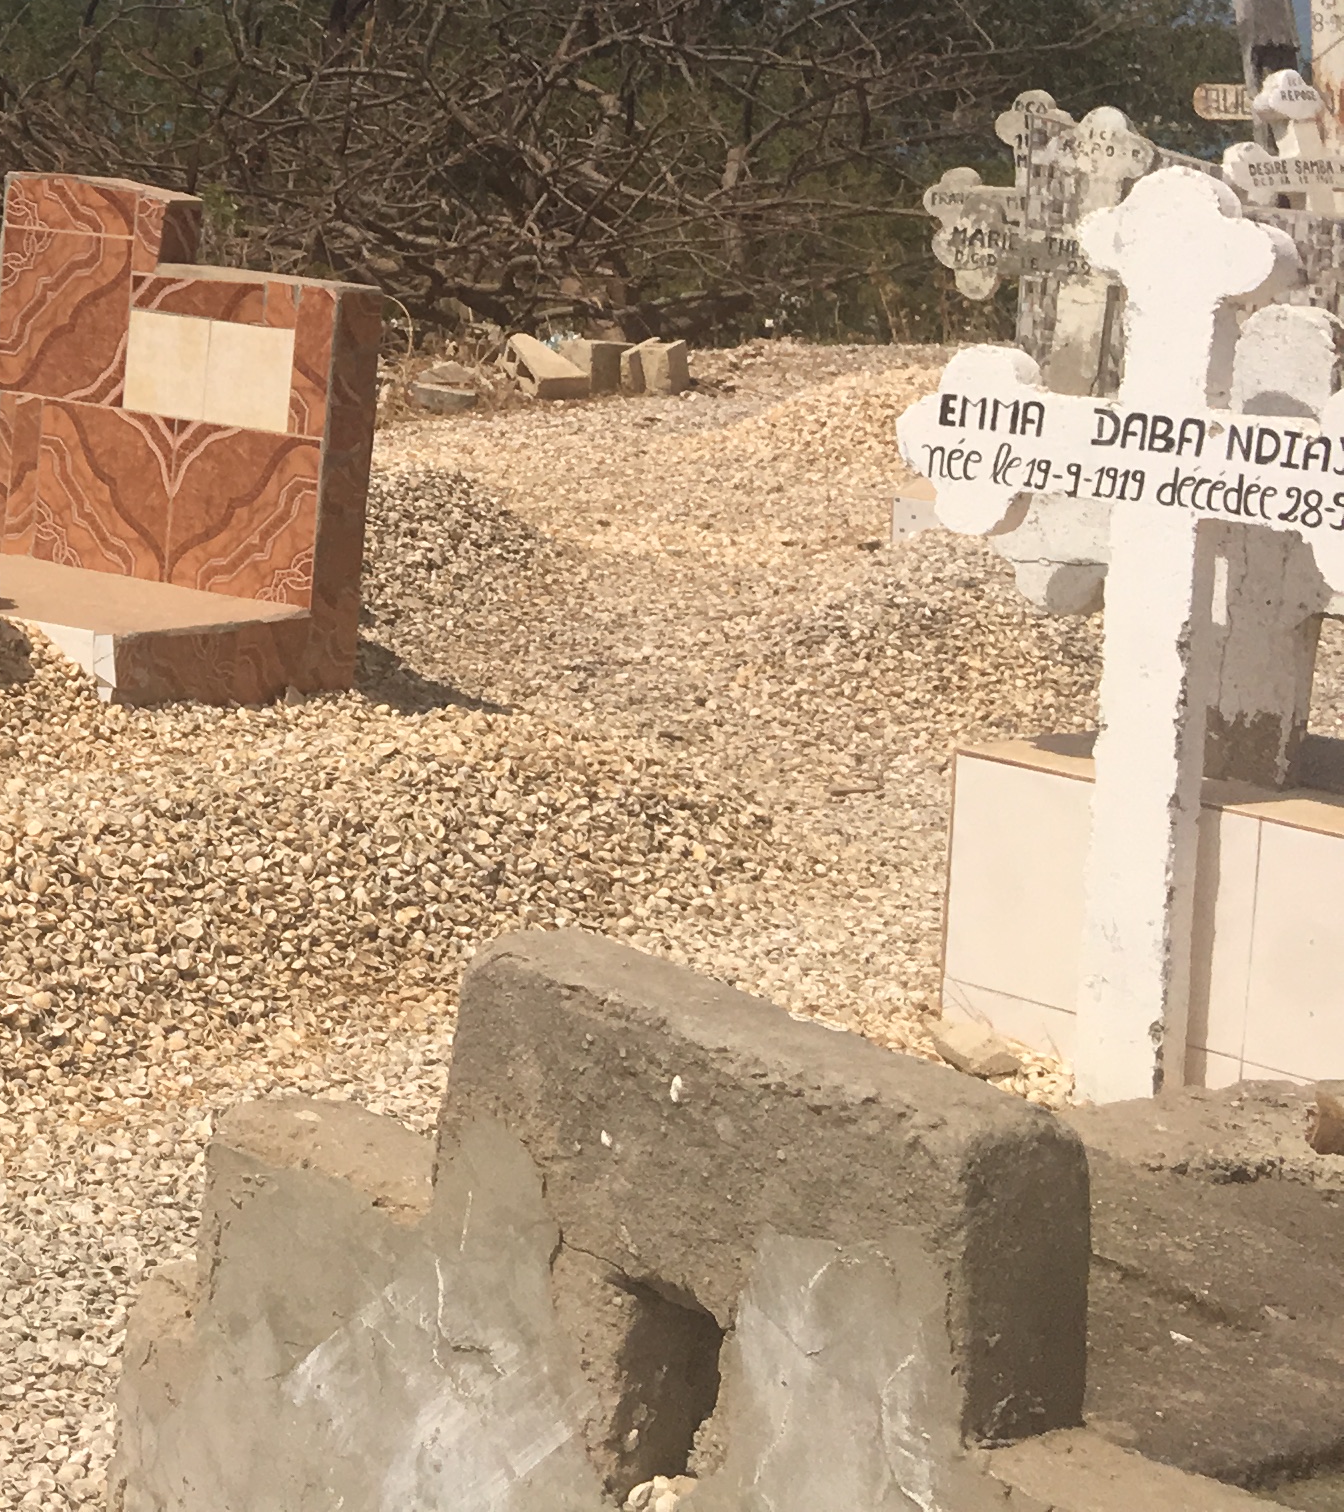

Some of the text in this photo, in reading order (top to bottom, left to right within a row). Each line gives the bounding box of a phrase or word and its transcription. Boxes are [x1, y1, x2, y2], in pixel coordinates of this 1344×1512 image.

[1280, 90, 1318, 101] REPOSE
[1248, 159, 1289, 176] DESIRE
[1295, 159, 1335, 175] SAMBA
[930, 192, 971, 206] FRAN
[953, 226, 1020, 251] MARIE
[938, 393, 1046, 438] EMMA
[1090, 407, 1206, 458] DABA
[922, 438, 983, 481] née
[993, 442, 1022, 487] le
[1023, 457, 1147, 501] 19-9-1919
[1156, 466, 1278, 520] décédée
